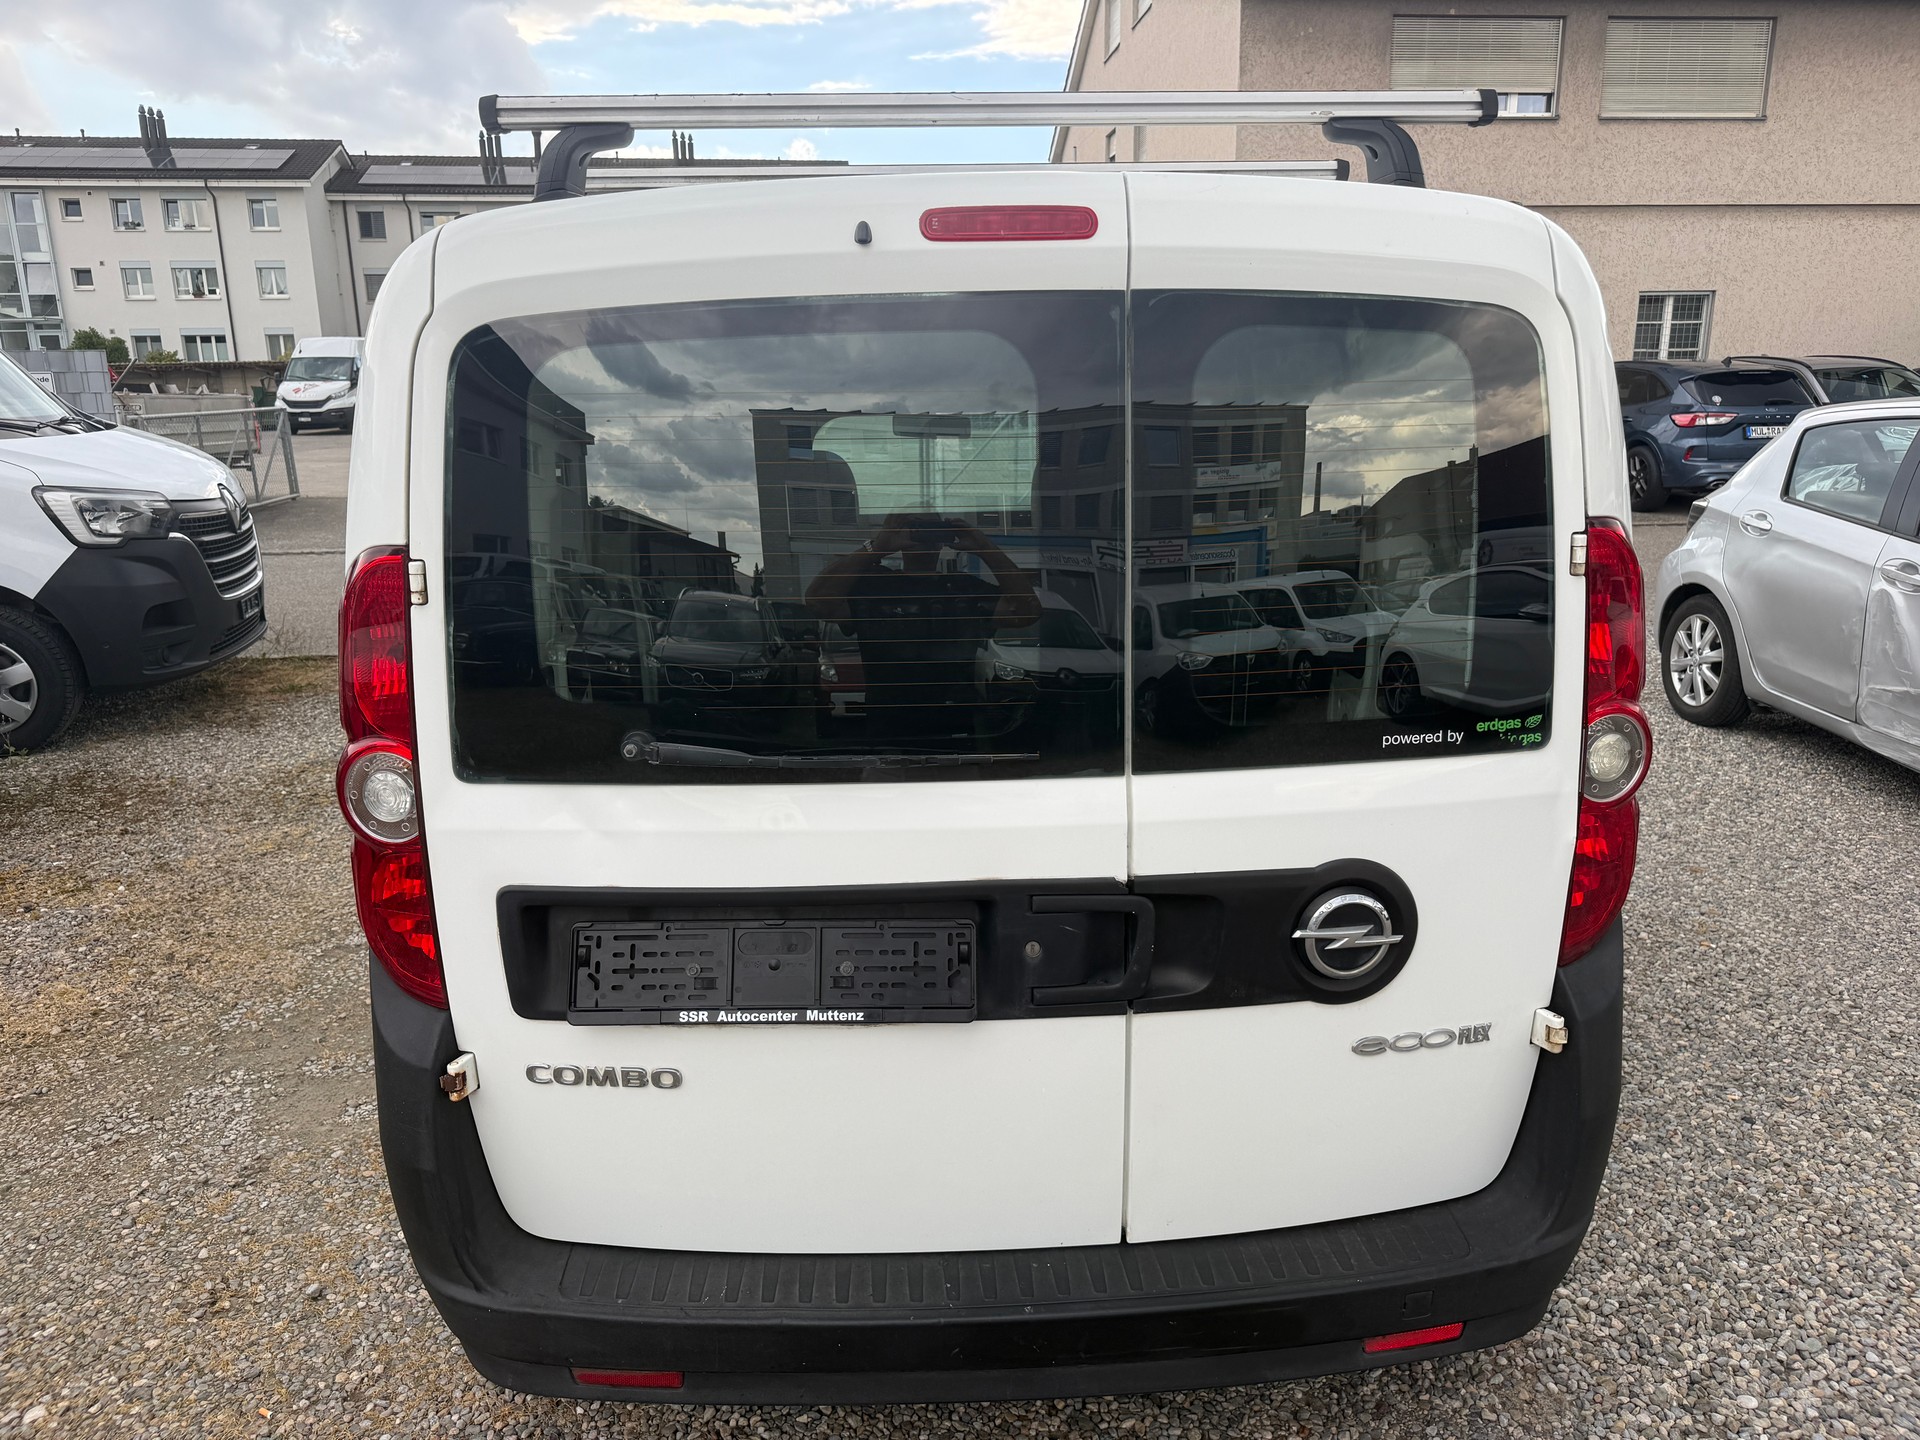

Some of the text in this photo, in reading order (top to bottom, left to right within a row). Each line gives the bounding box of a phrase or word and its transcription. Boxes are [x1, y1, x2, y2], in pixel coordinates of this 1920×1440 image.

[1476, 718, 1522, 732] erdgas
[1382, 729, 1464, 748] powered by
[679, 1009, 865, 1023] SSR Autocenter Muttenz
[525, 1062, 683, 1090] COMBO
